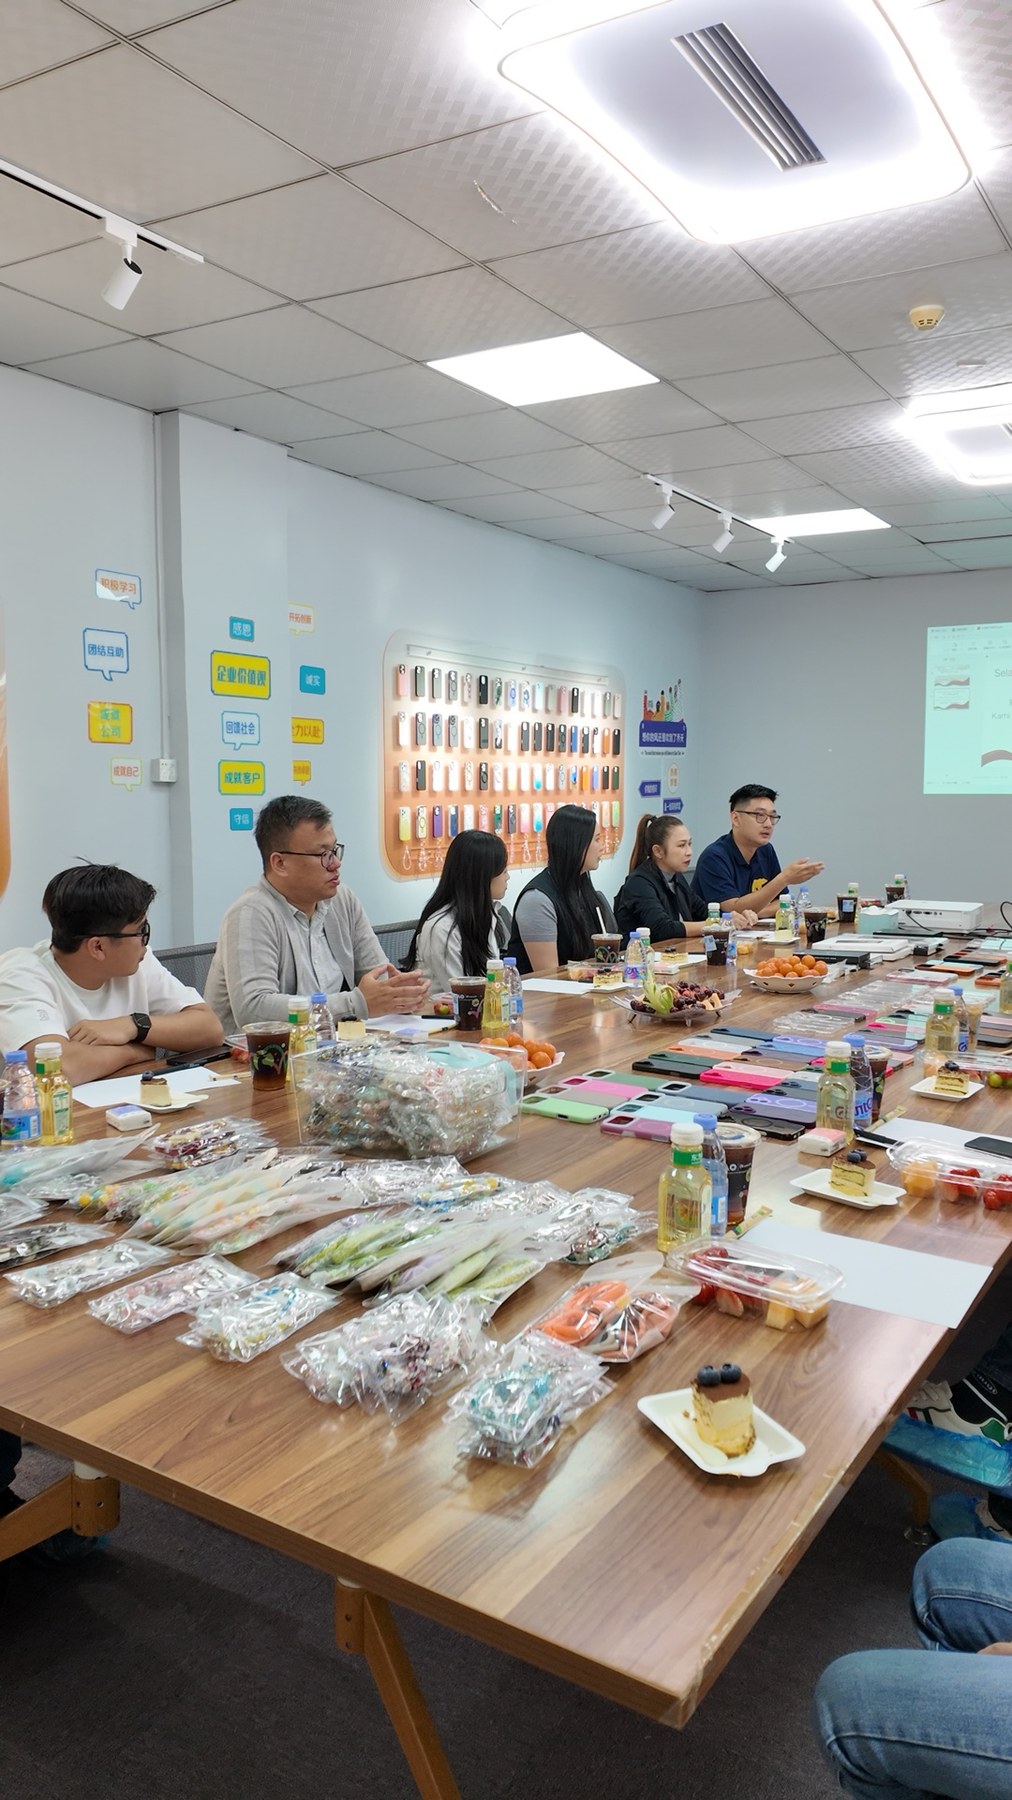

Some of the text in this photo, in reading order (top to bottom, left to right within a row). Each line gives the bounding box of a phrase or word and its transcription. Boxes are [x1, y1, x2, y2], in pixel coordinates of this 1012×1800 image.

[87, 643, 124, 658] 团结互助
[217, 664, 267, 687] 企业价值观
[225, 720, 255, 735] 回馈社会
[224, 771, 261, 785] 成就客户
